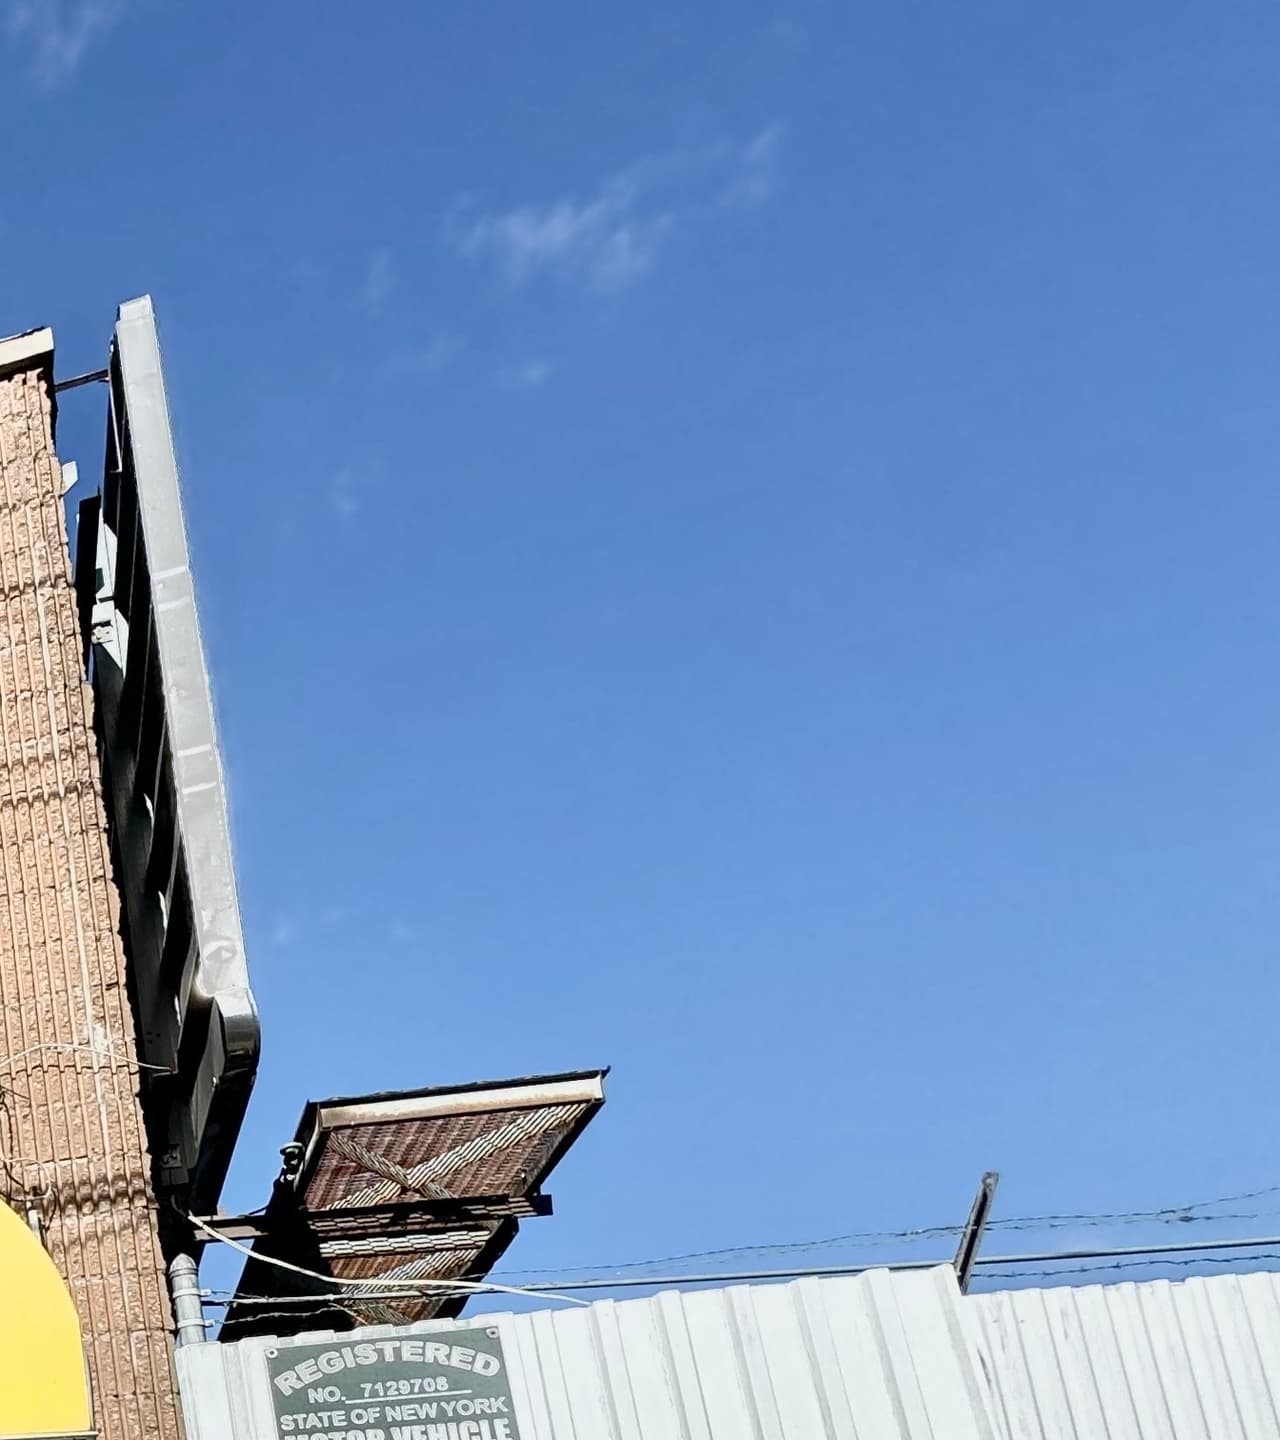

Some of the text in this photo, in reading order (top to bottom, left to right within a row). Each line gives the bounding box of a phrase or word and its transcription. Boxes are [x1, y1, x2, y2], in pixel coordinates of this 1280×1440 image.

[273, 1340, 501, 1396] REGISTERED
[307, 1376, 449, 1404] NO. 7129708
[279, 1396, 509, 1431] STATE OF NEW YORK
